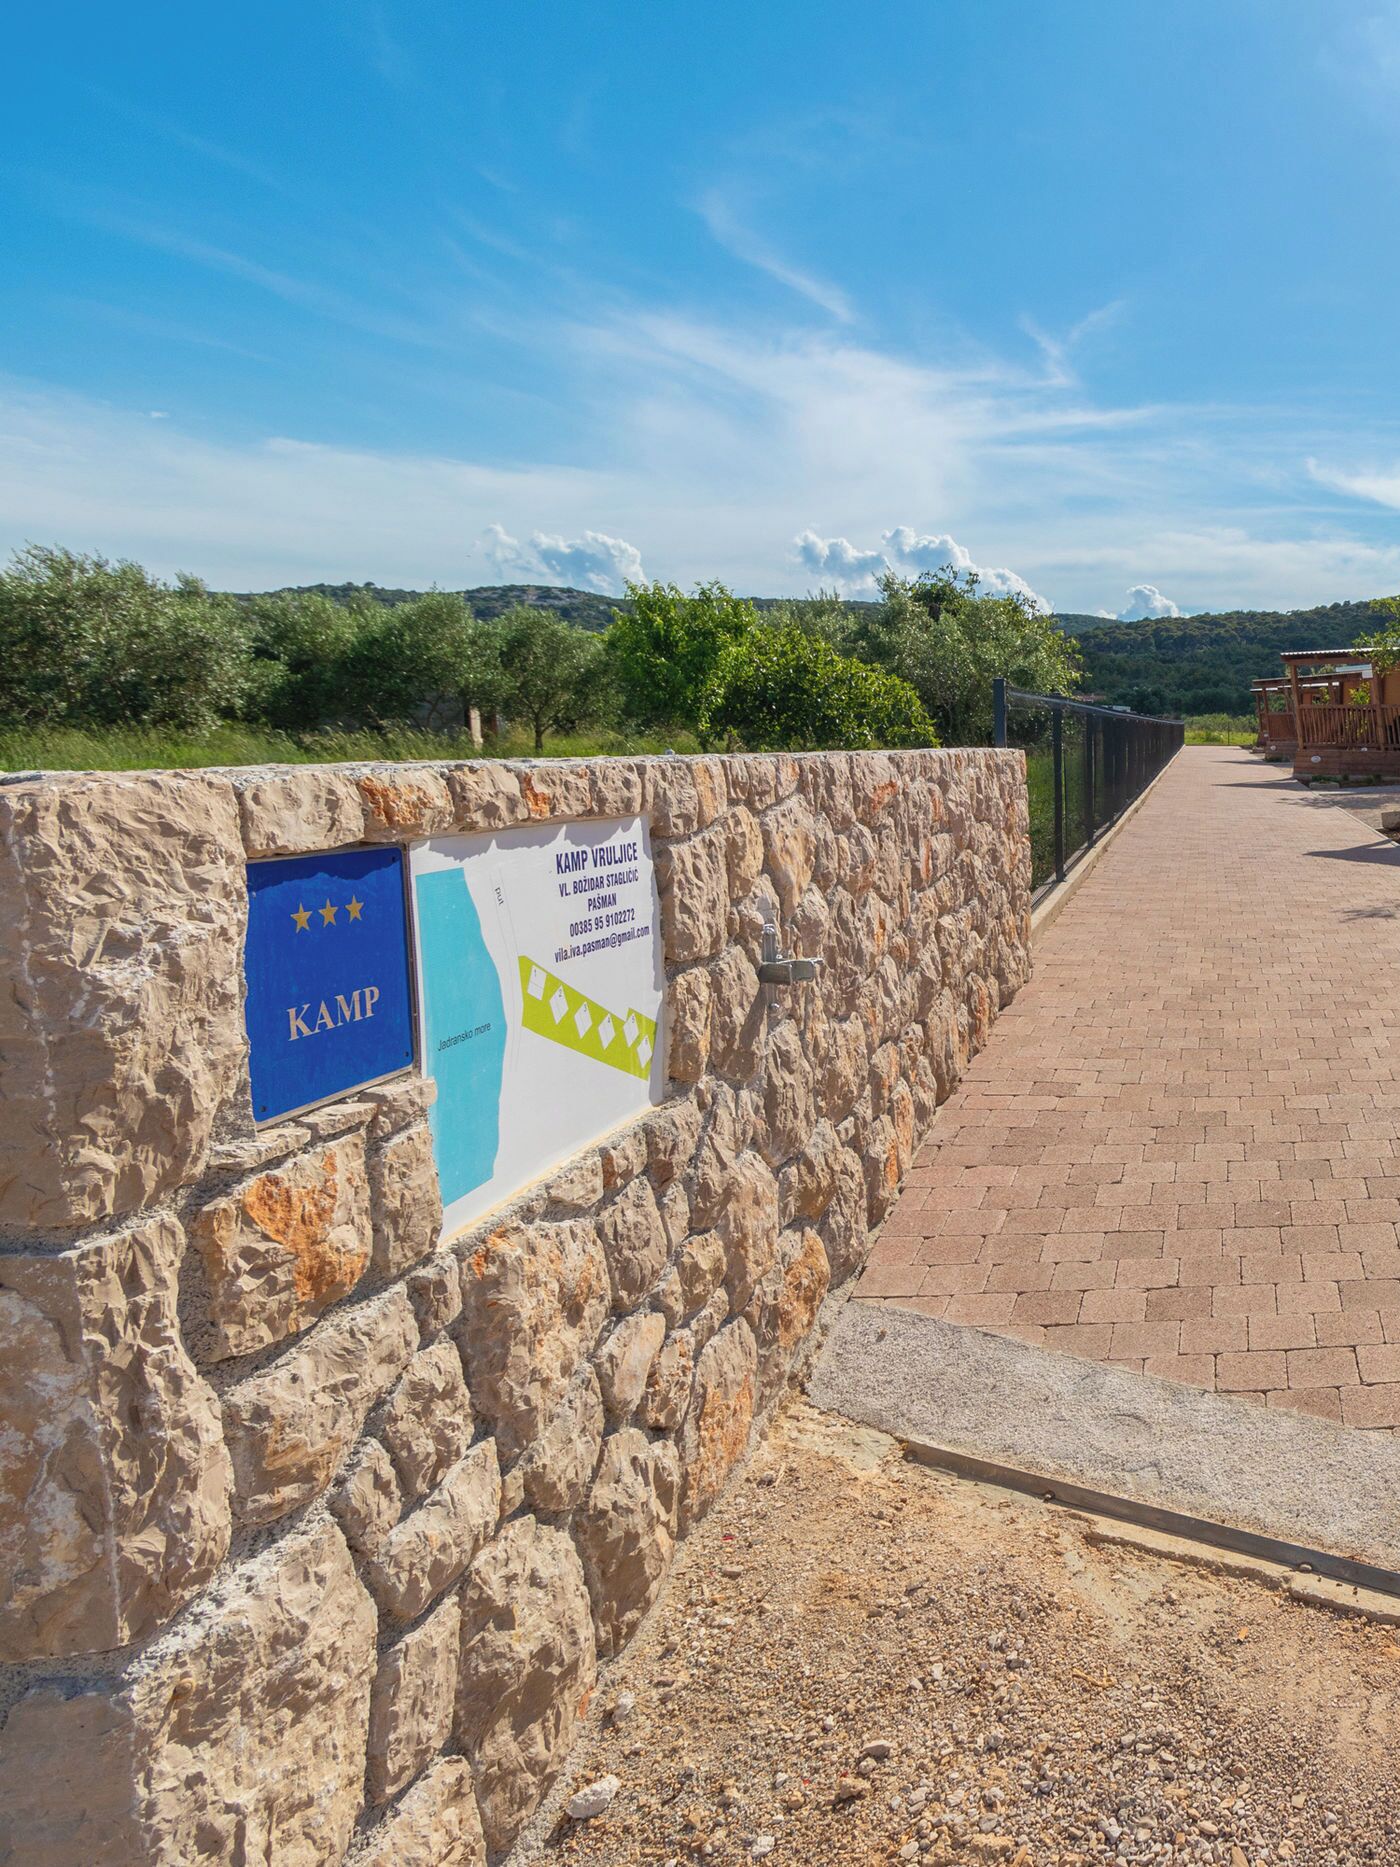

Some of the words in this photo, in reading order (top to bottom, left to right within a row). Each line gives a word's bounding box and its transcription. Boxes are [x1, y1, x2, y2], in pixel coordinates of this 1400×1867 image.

[556, 850, 588, 875] KAMP
[591, 842, 638, 868] VRULJICE
[559, 883, 571, 897] VL.
[573, 876, 605, 895] BOŽIDAR
[588, 893, 617, 912] PAŠMAN
[569, 919, 592, 937] 00385
[594, 916, 604, 930] 95
[606, 908, 635, 928] 9102272
[554, 925, 650, 963] vila.iva.pasman@gmail.com
[286, 986, 380, 1041] KAMP
[437, 1029, 473, 1051] Jadransko
[474, 1022, 492, 1036] more
